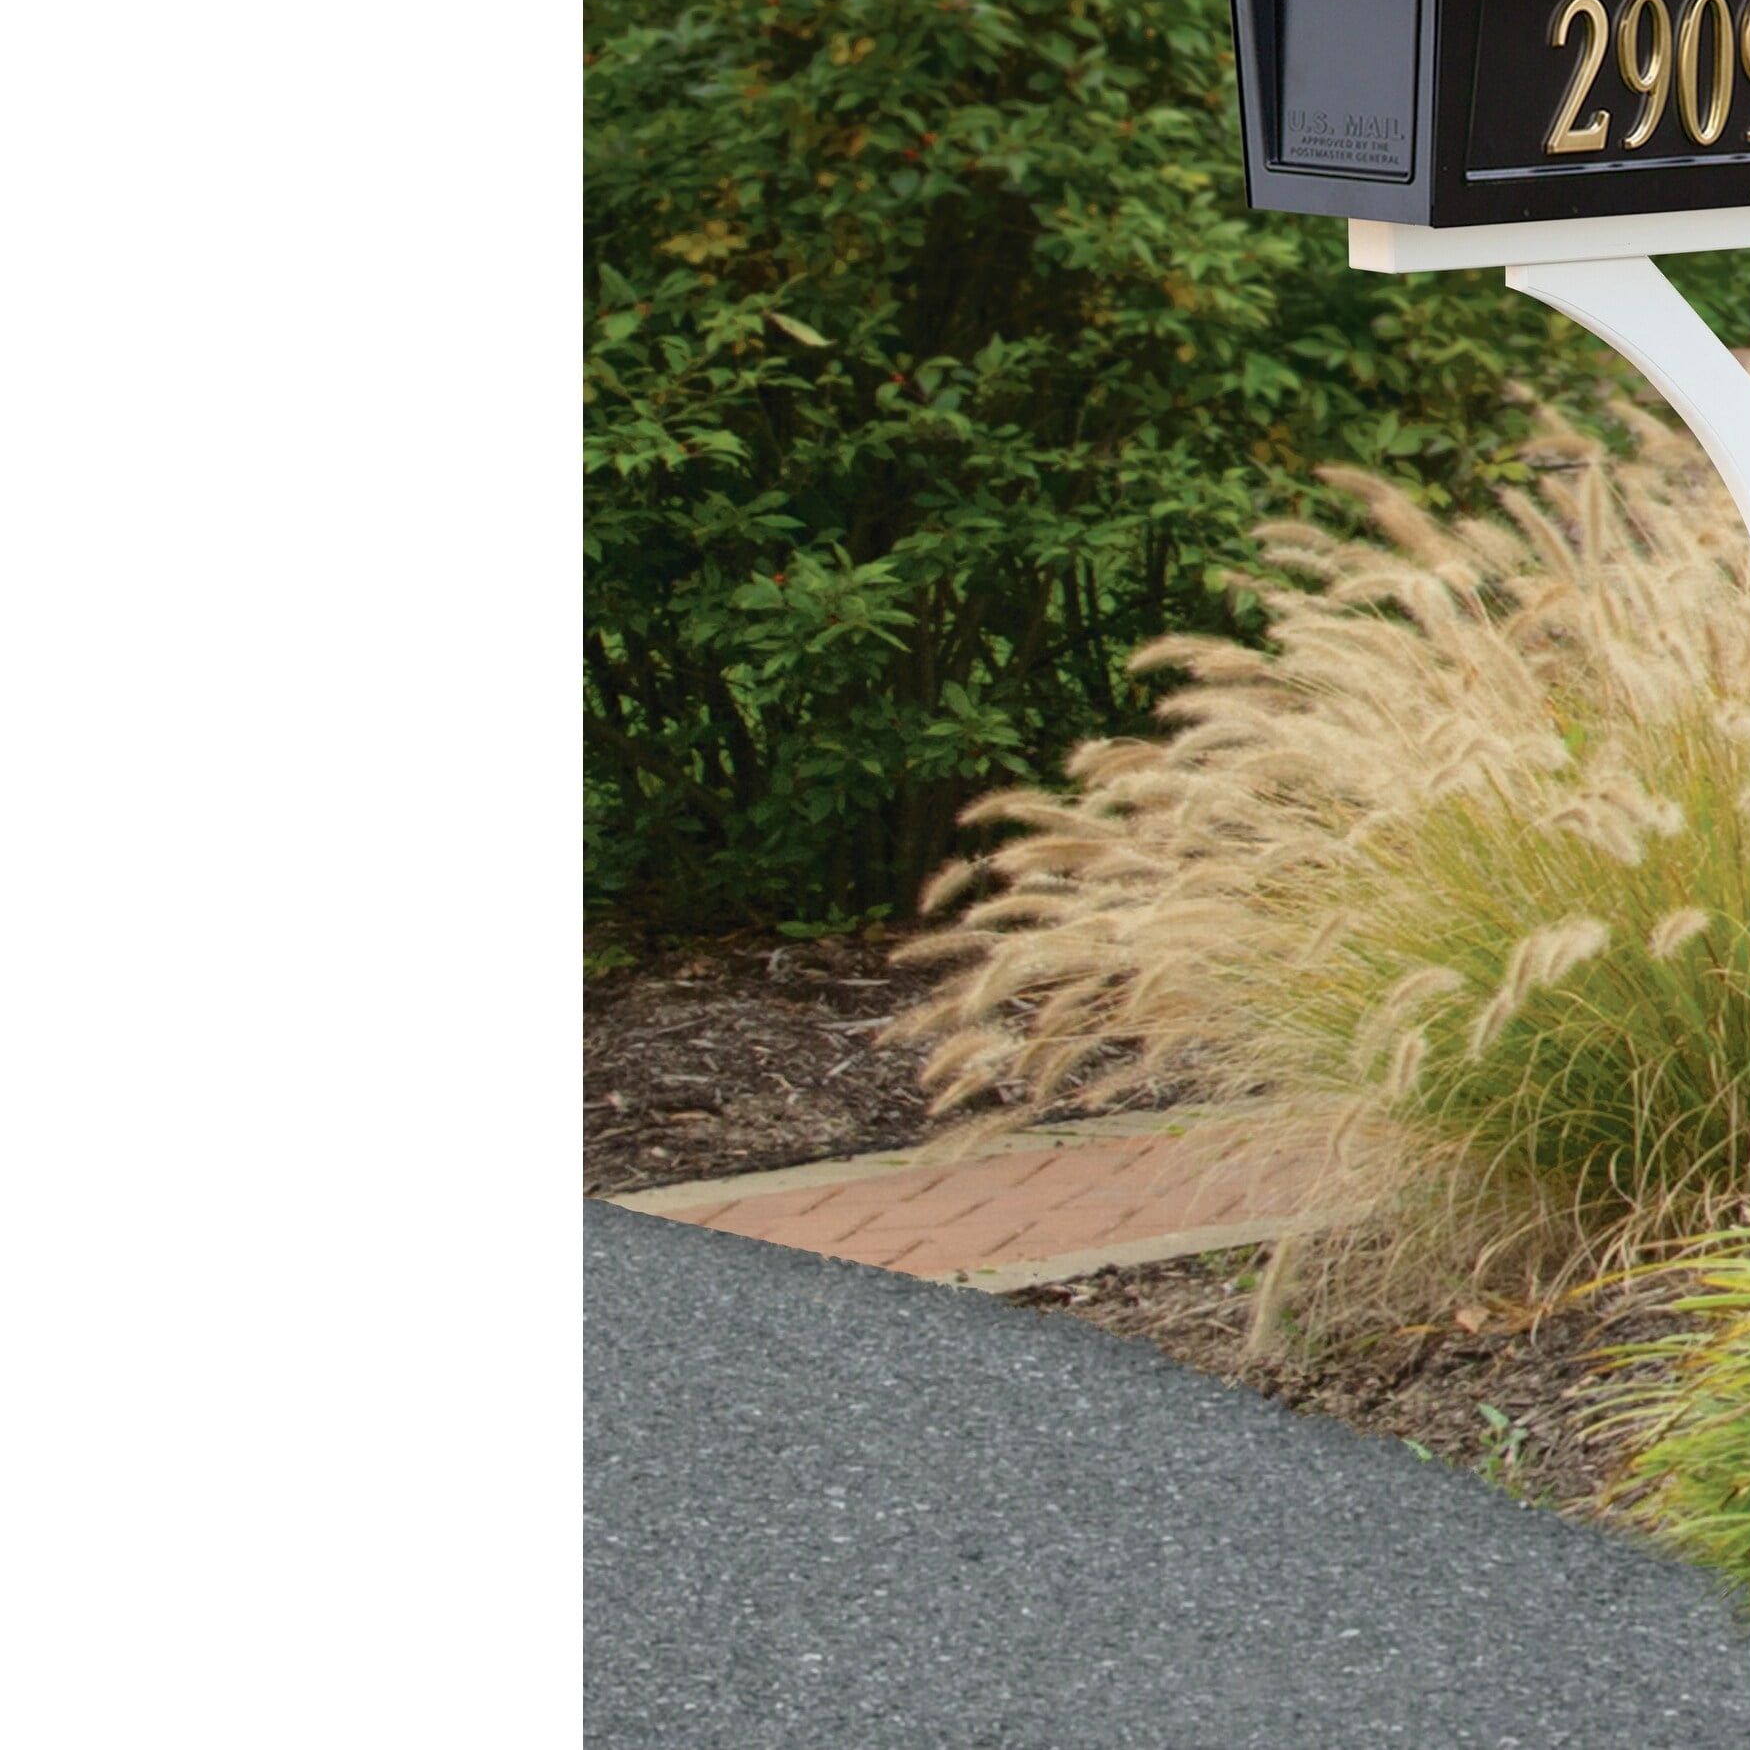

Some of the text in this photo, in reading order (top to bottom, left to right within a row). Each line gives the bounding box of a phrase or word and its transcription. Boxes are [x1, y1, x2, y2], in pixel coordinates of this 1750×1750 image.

[1287, 110, 1405, 140] U.S. MAIL
[1302, 136, 1389, 152] APPROVED BY THE
[1289, 147, 1400, 165] POSTMASTER GENERAL
